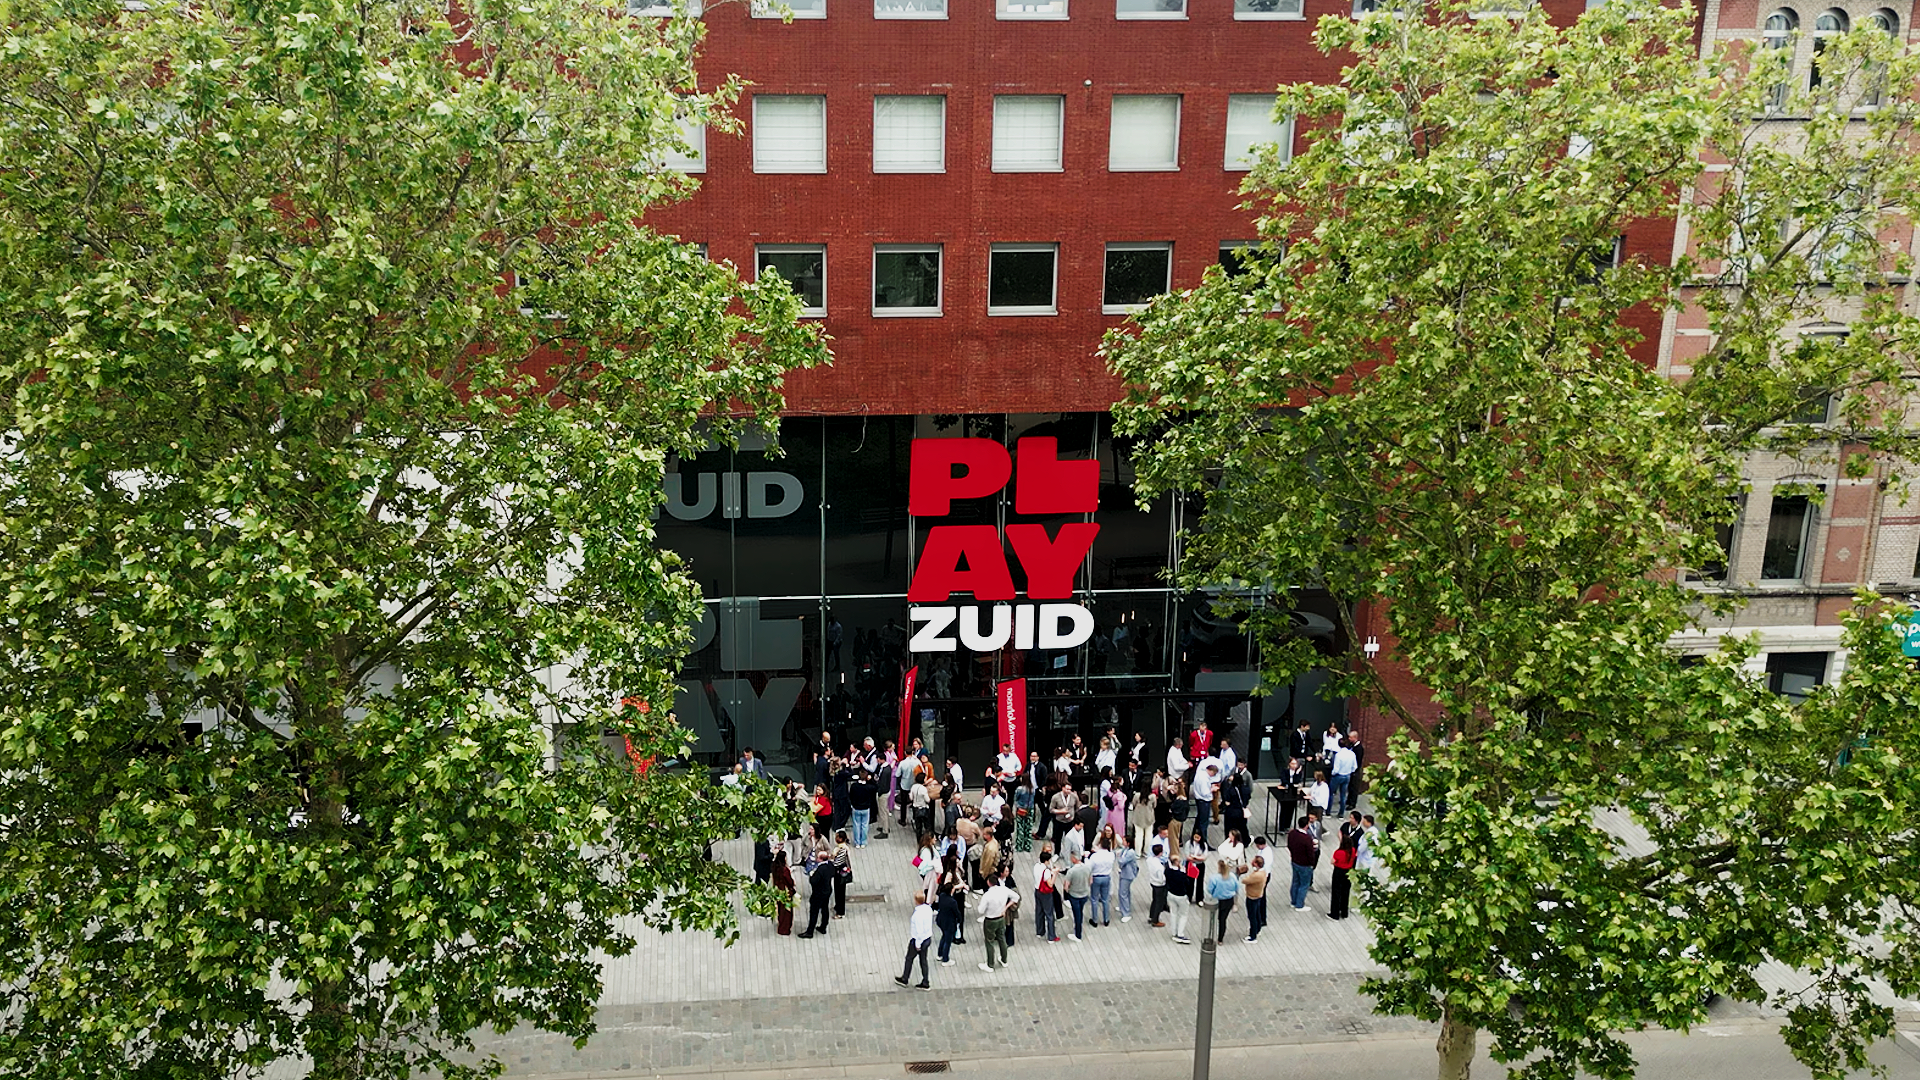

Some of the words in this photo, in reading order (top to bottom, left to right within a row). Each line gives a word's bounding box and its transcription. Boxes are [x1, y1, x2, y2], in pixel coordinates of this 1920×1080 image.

[650, 471, 804, 521] UID
[909, 436, 1100, 516] PL
[907, 523, 1100, 602] AY
[909, 603, 1095, 653] ZUID
